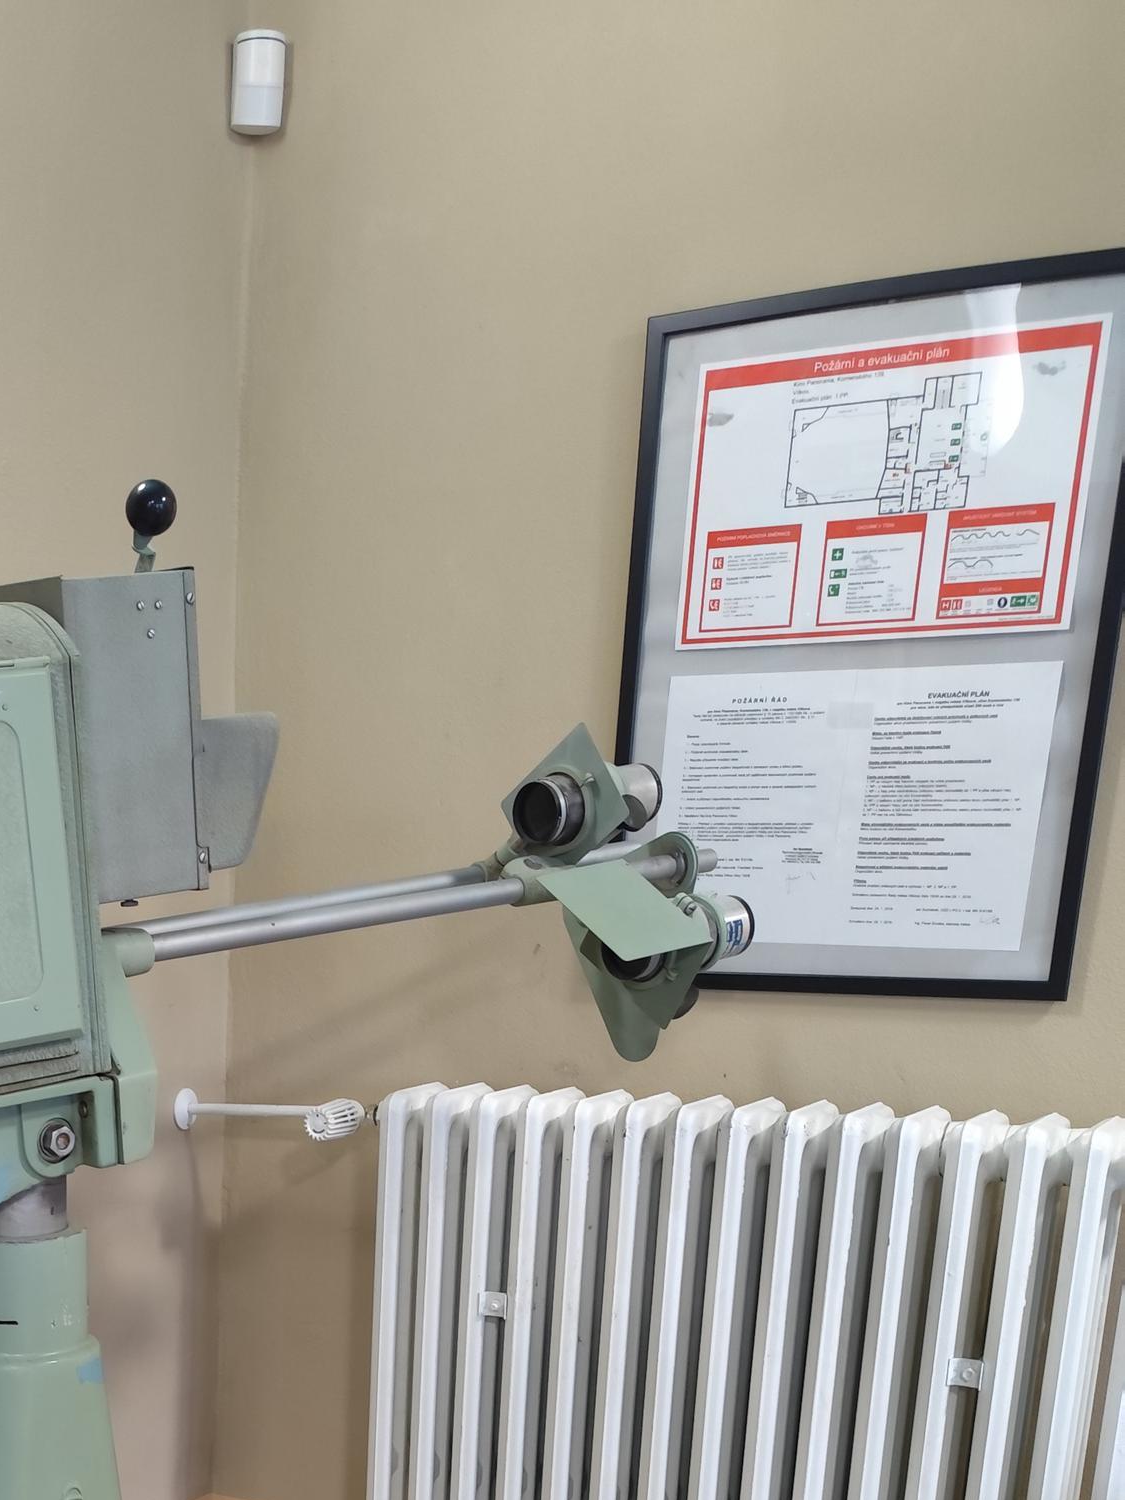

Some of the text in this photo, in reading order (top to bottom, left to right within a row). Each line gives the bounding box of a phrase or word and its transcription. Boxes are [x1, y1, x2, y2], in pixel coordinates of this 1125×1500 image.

[813, 347, 950, 373] Požární a evakuační plán
[927, 689, 990, 699] EVAKUAČNÍ PLÁN
